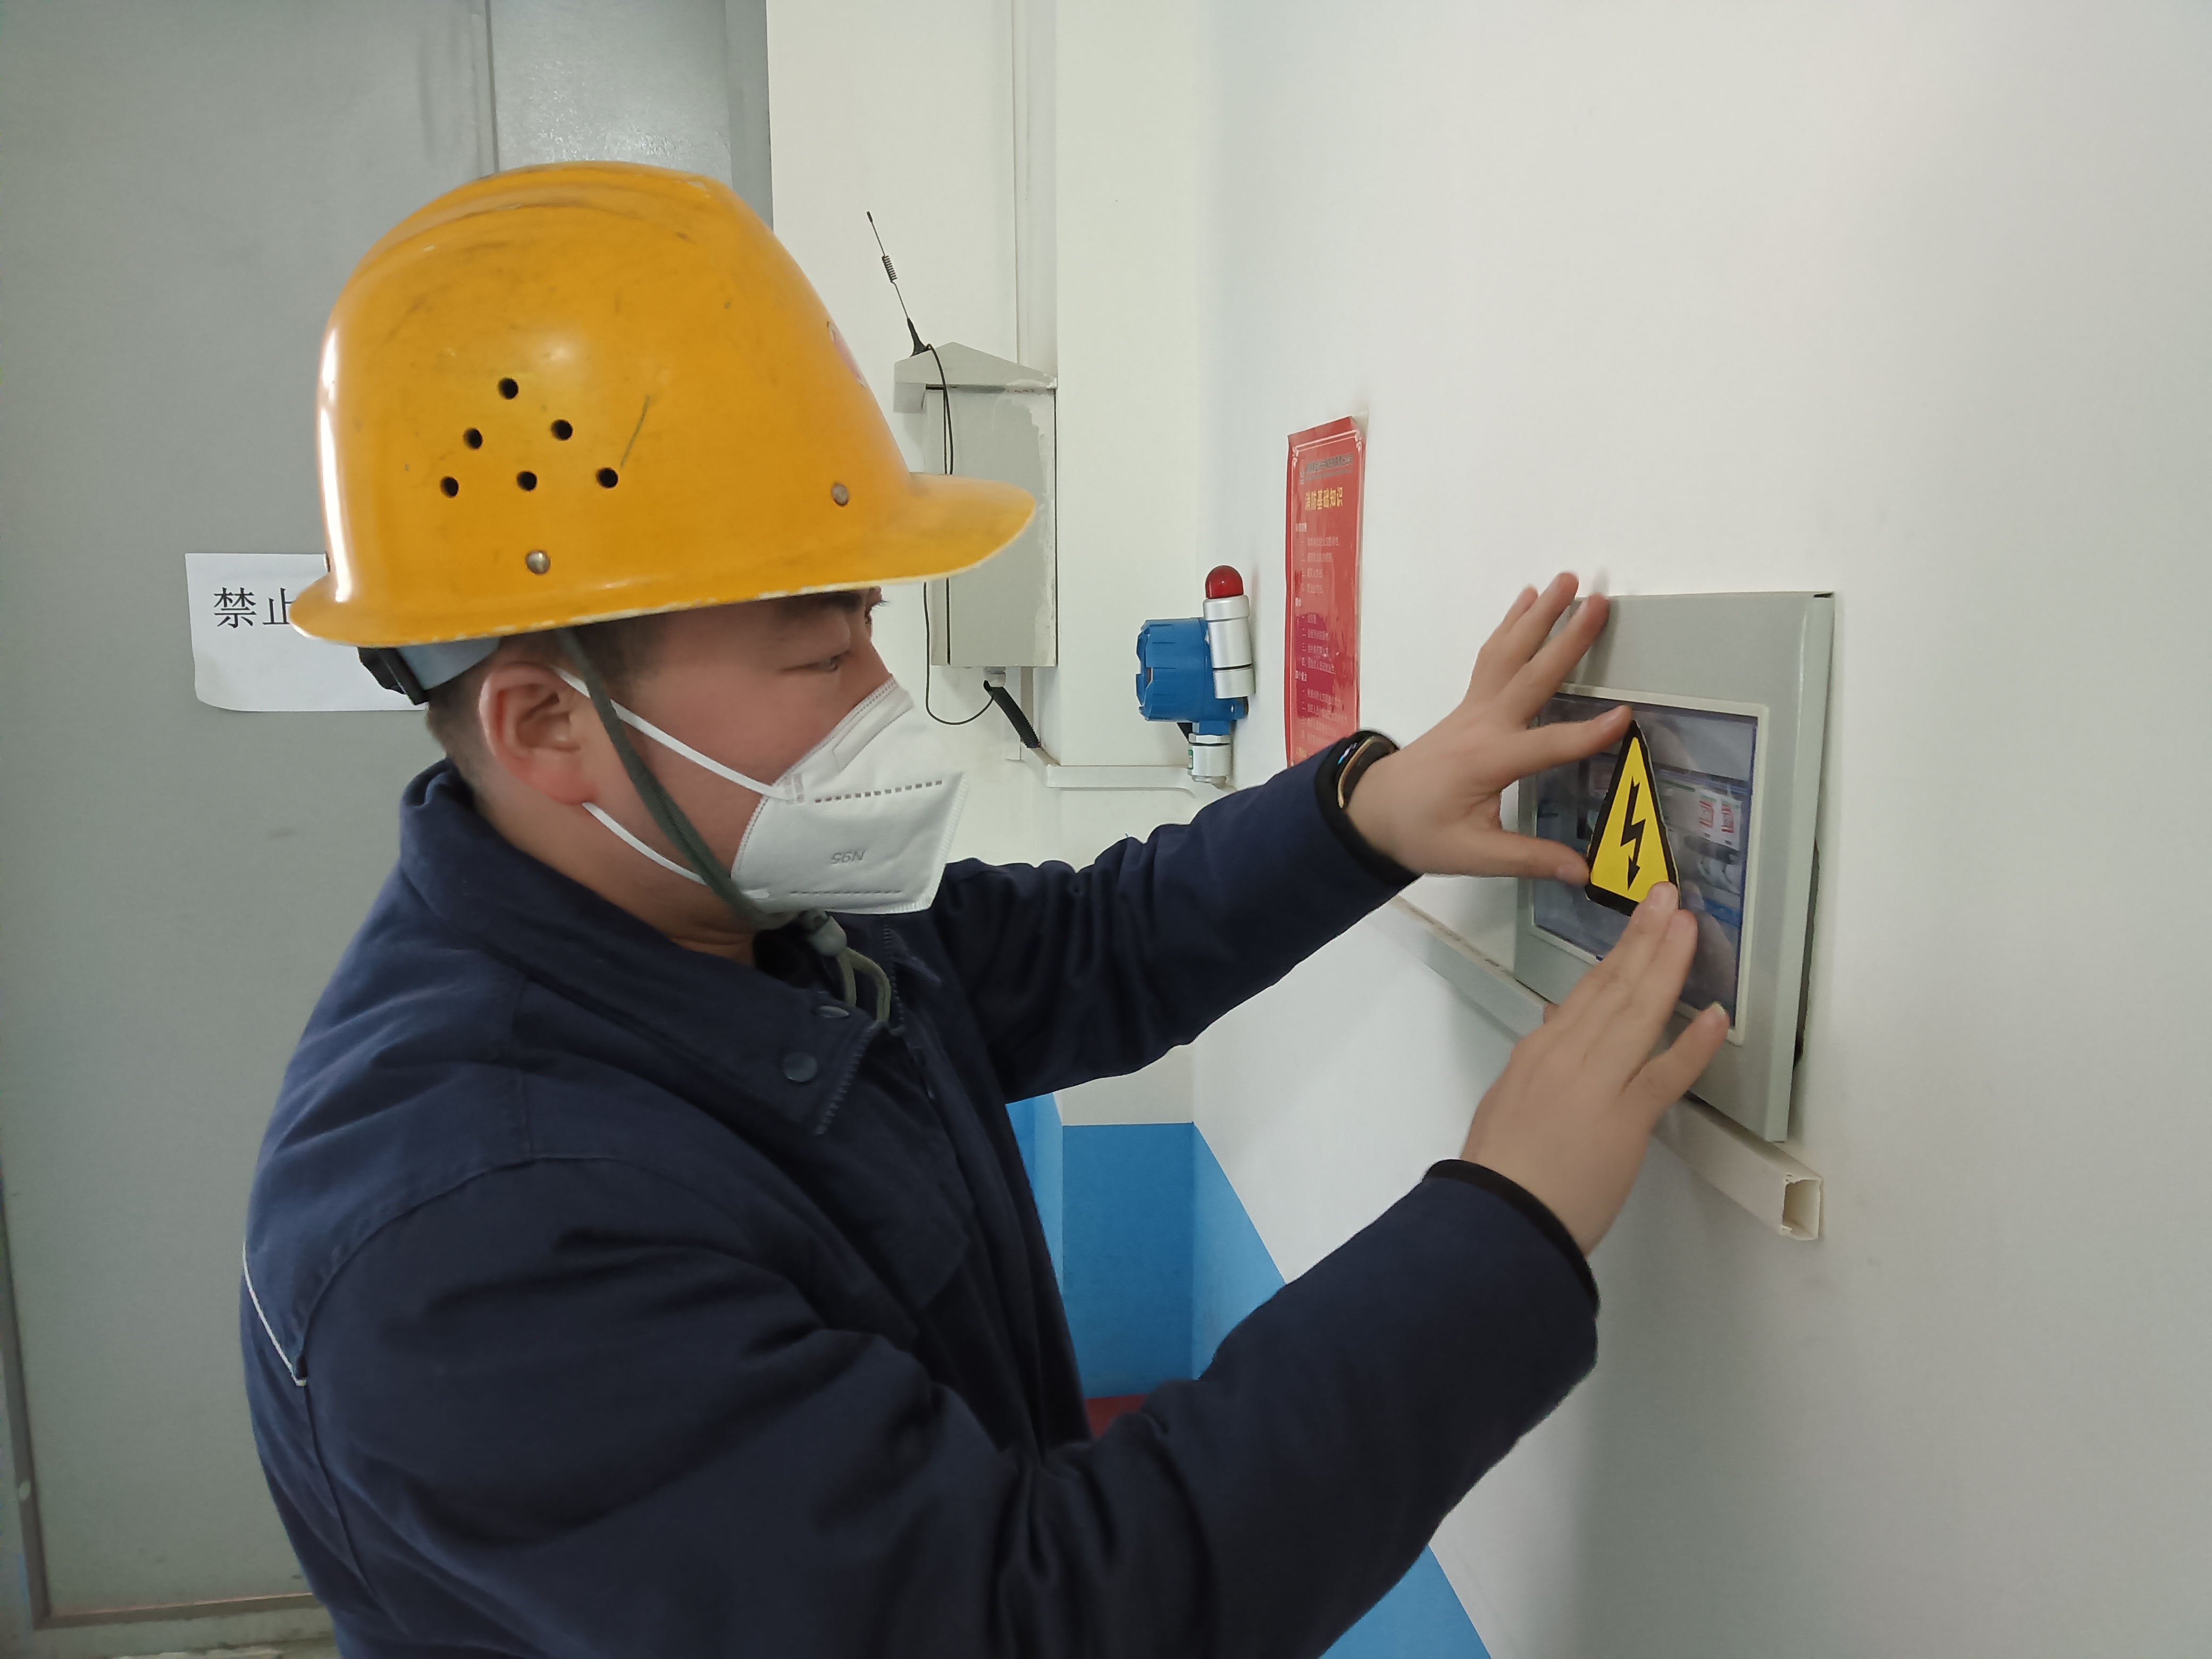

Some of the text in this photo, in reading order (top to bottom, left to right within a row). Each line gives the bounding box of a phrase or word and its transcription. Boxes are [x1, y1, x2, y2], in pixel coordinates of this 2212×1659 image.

[1305, 487, 1343, 511] 消防基础知识
[214, 587, 296, 628] 禁止
